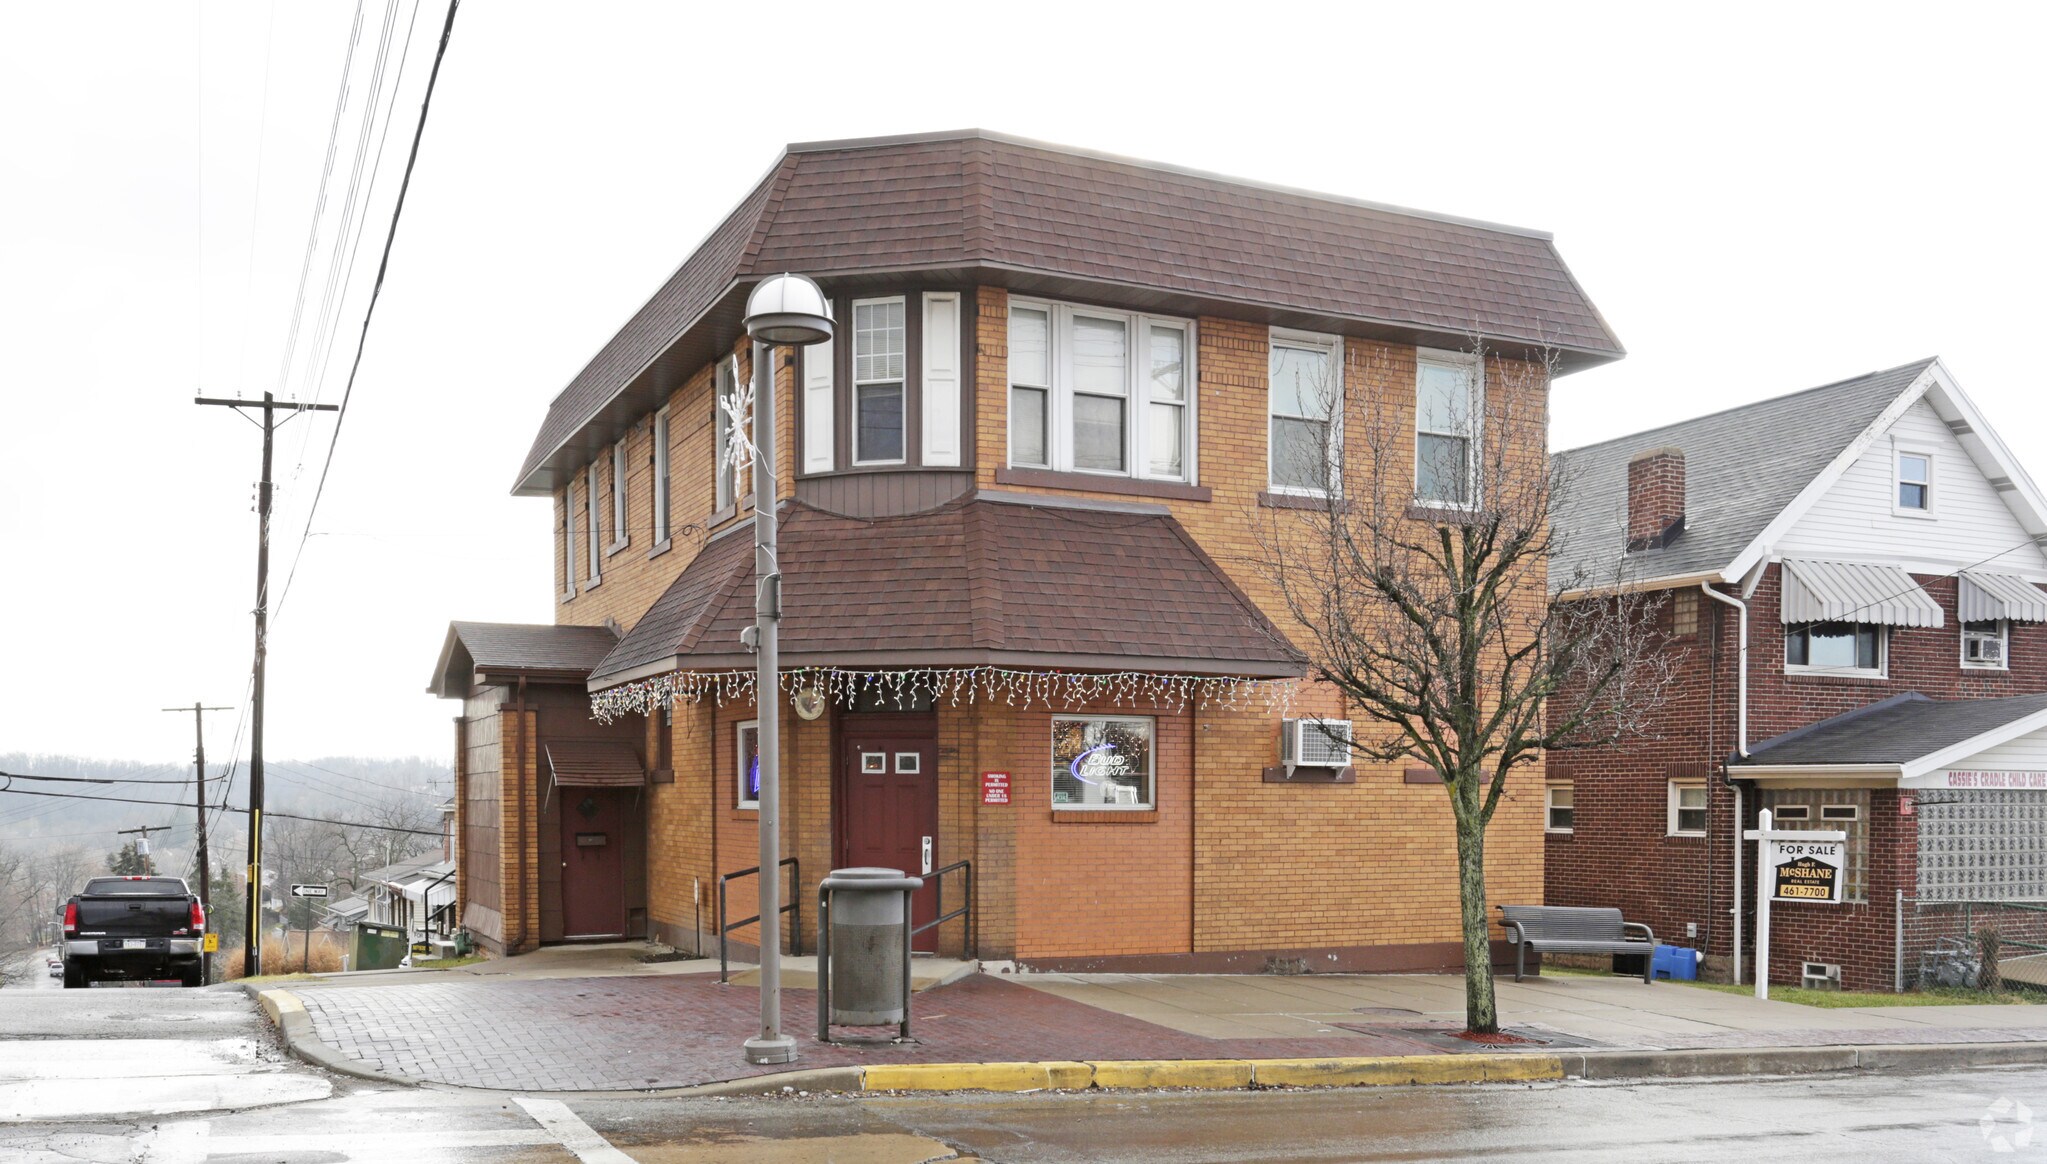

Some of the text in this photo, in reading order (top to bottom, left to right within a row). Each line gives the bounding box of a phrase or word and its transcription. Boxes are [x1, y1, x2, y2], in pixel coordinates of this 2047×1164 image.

[1087, 754, 1125, 766] BUD
[1080, 765, 1130, 777] LIGHT
[1948, 771, 2046, 787] CASSIE'S CRADLE CHILD CARE
[1779, 845, 1836, 855] FOR SALE
[1779, 867, 1833, 879] McSHANE
[1783, 886, 1826, 897] 461-7700
